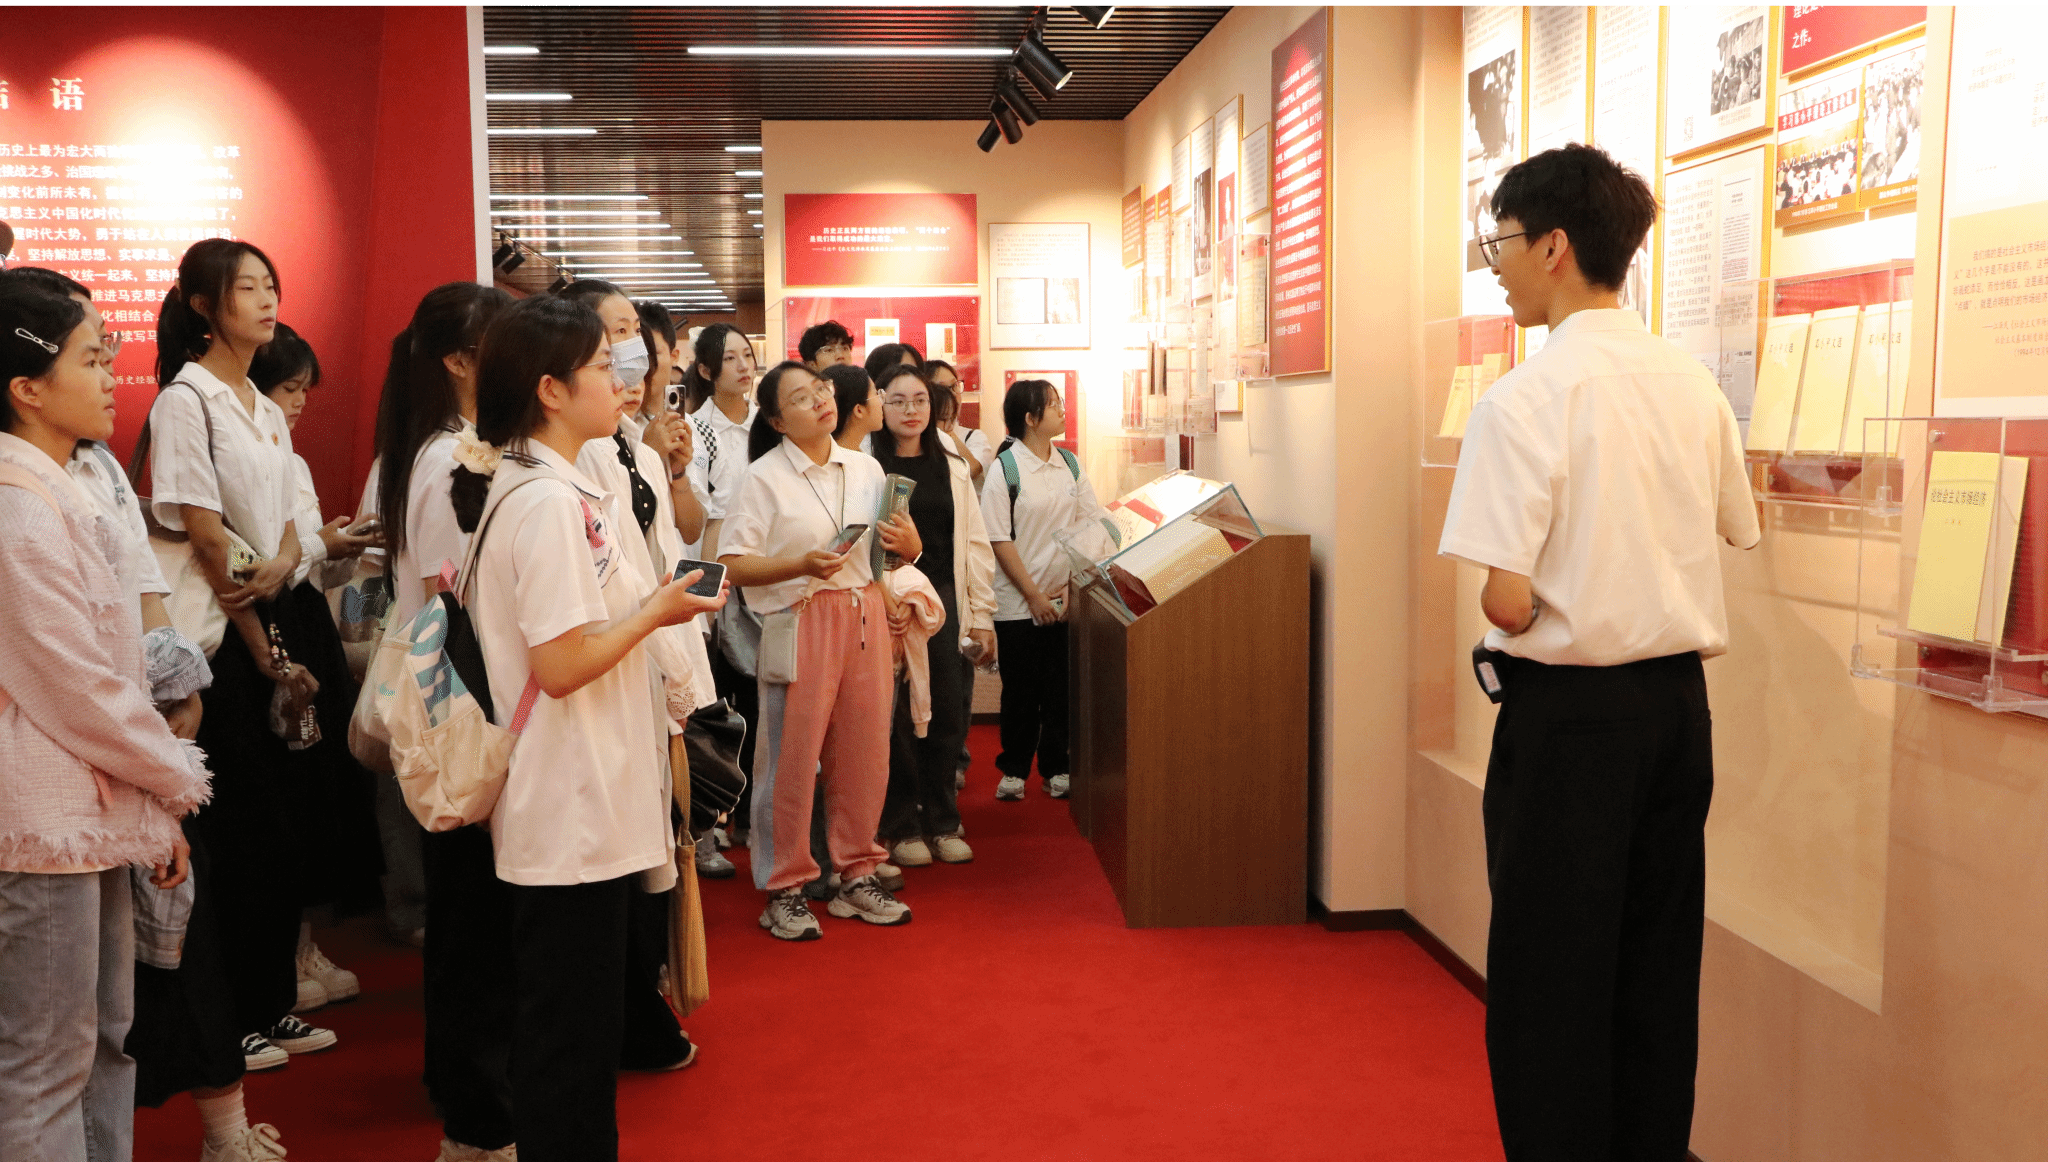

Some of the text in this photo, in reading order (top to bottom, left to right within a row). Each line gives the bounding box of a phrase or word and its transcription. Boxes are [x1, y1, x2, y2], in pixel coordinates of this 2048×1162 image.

[1792, 29, 1811, 48] 之作。
[50, 77, 85, 111] 语
[101, 309, 154, 323] 化相结合
[121, 330, 157, 343] 续写马
